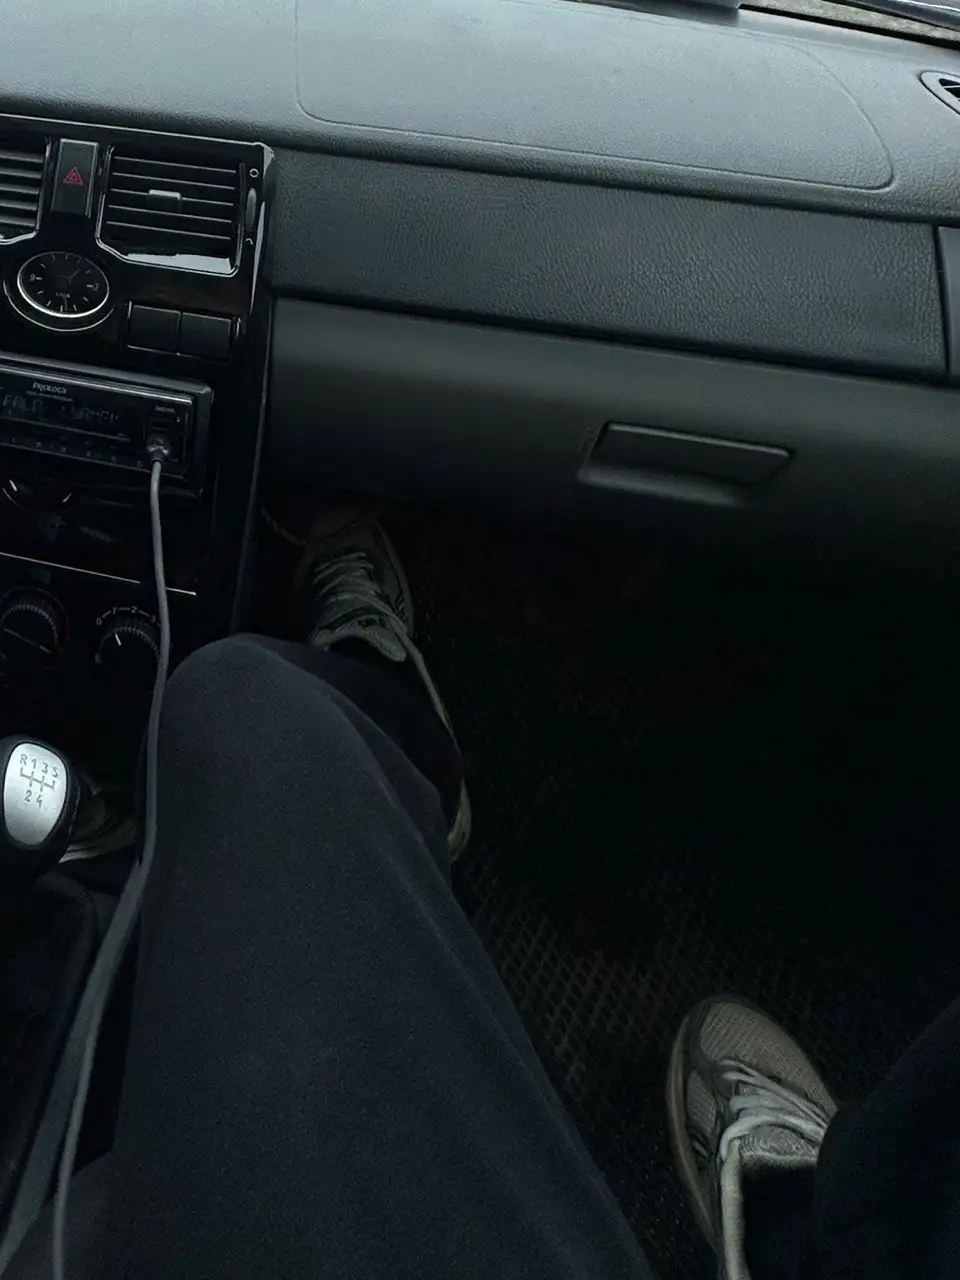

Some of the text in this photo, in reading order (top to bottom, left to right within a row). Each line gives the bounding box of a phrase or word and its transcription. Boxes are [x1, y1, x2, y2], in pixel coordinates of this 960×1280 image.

[20, 753, 59, 778] R 1 3 5
[24, 789, 43, 808] 2 4
